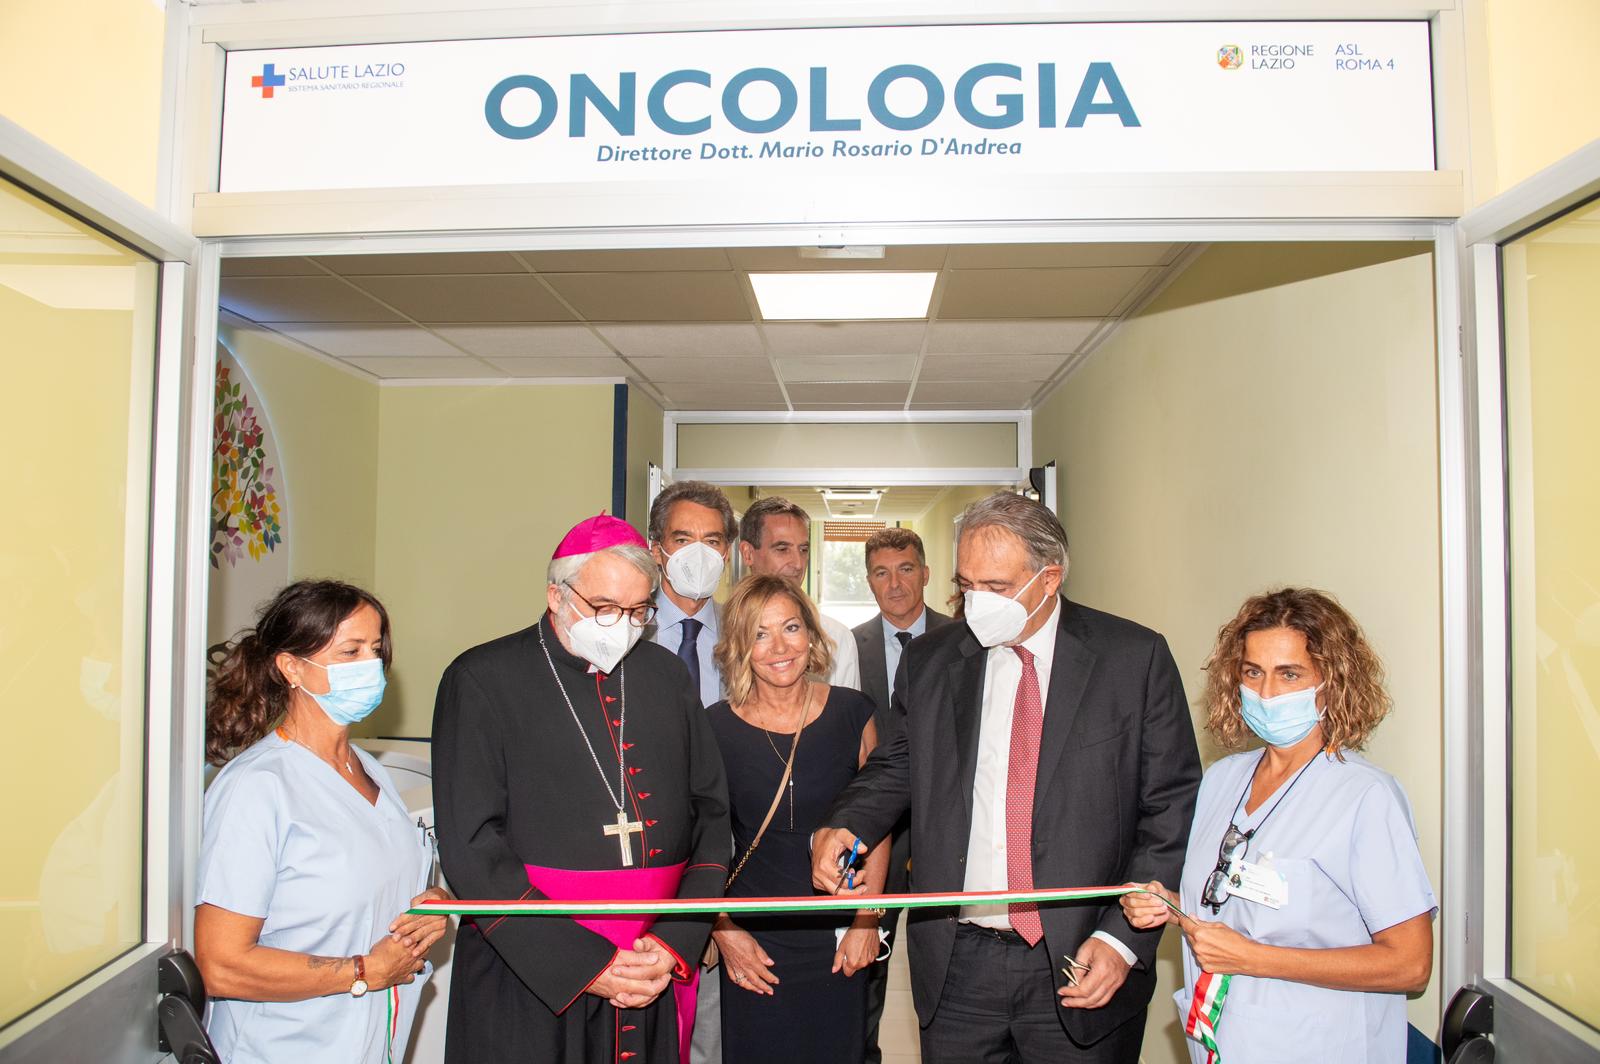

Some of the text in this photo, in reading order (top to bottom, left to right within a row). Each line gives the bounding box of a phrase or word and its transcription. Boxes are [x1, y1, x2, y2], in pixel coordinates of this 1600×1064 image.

[1251, 44, 1314, 56] REGIONE
[1335, 43, 1362, 56] ASL
[1251, 58, 1295, 70] LAZIO
[1335, 58, 1395, 71] ROMA 4
[288, 62, 405, 81] SALUTE LAZIO
[361, 80, 404, 89] REGIONALE
[484, 62, 1142, 140] ONCOLOGIA
[597, 137, 1022, 162] Direttore Dott. Mario Rosario D'Andrea
